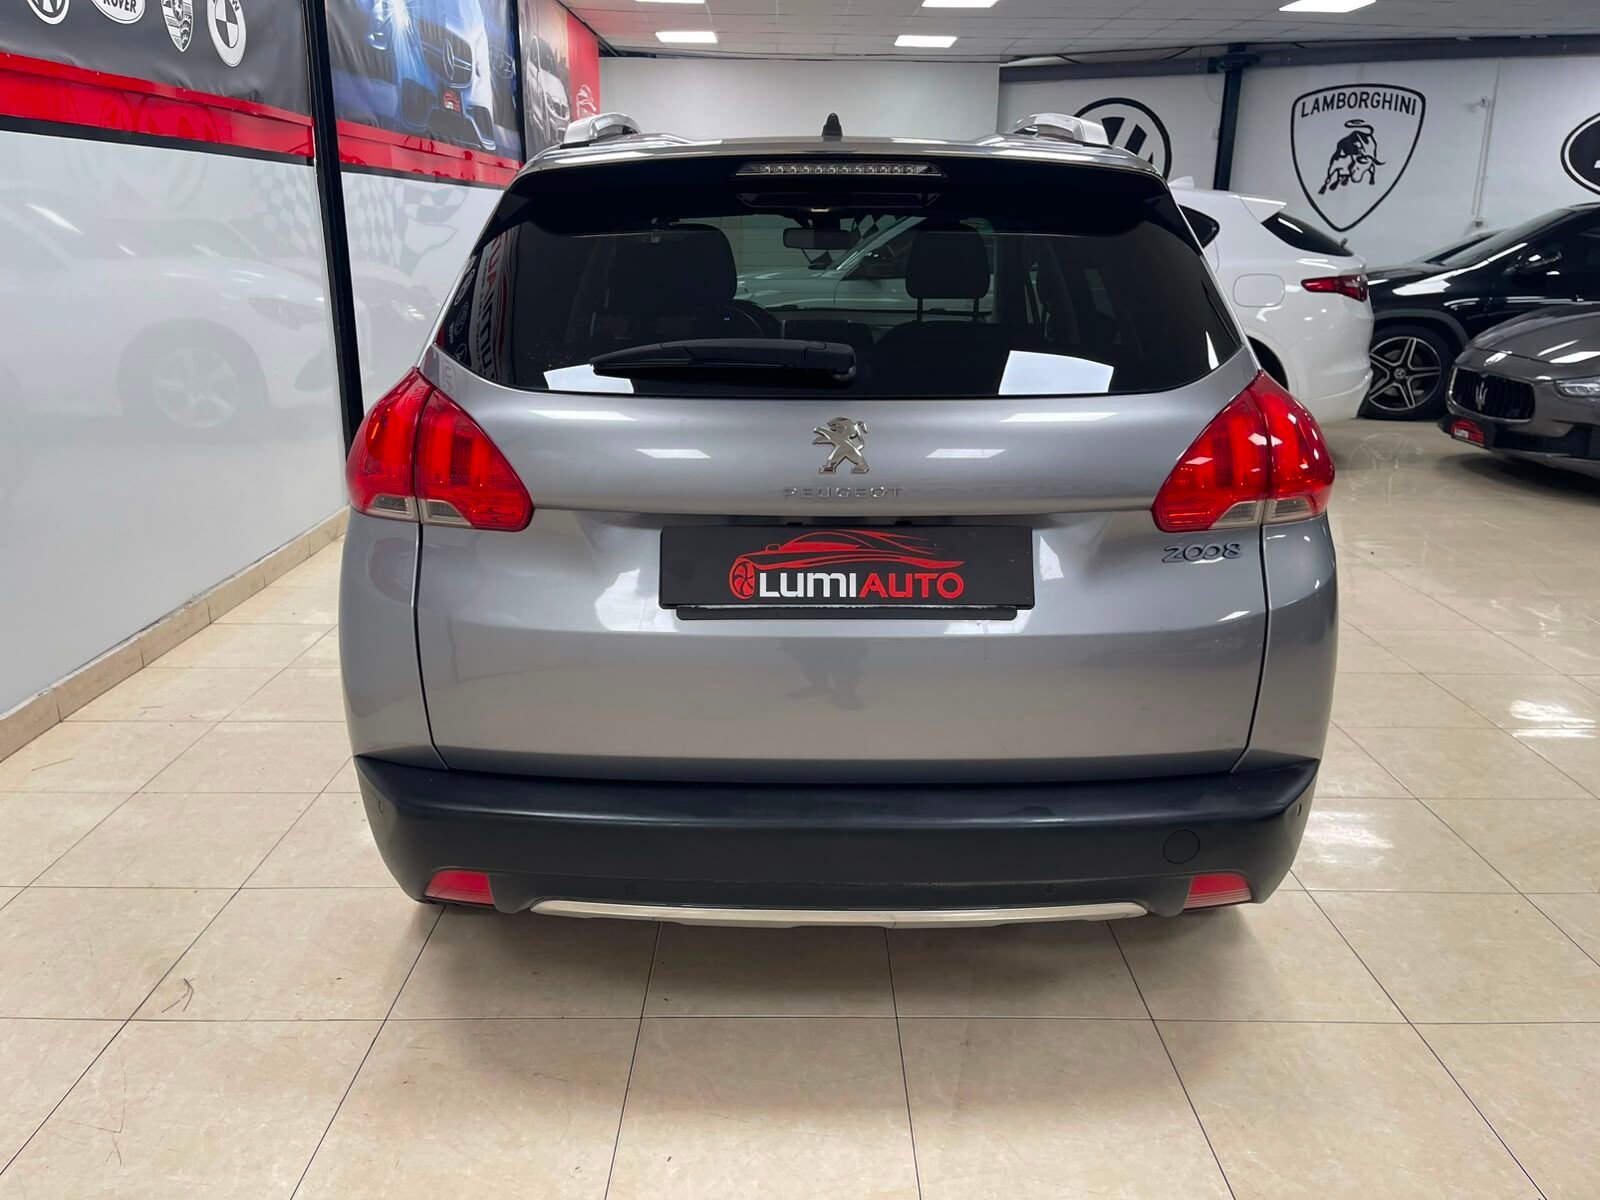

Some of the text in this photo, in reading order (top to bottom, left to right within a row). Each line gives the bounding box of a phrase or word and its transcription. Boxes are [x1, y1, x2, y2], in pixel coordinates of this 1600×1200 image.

[1301, 91, 1417, 118] LAMBORGHINI
[784, 486, 903, 498] PEUGEOT
[1162, 542, 1241, 563] 2008
